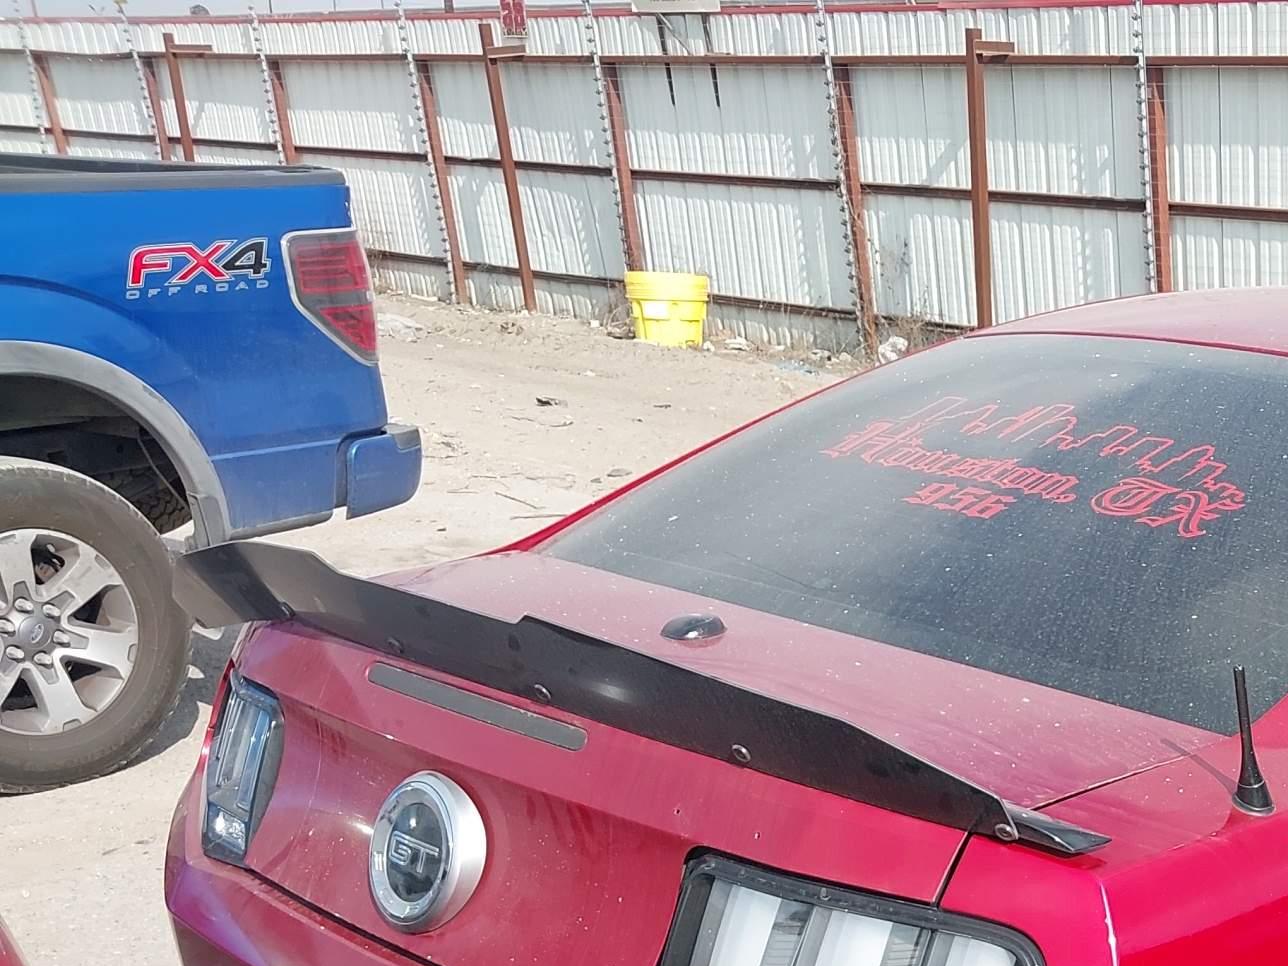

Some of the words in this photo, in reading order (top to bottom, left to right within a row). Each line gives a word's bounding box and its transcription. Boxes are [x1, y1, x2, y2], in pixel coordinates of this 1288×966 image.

[126, 237, 271, 288] FX4
[125, 286, 181, 300] OFF
[195, 279, 269, 293] ROAD
[388, 831, 440, 873] GT
